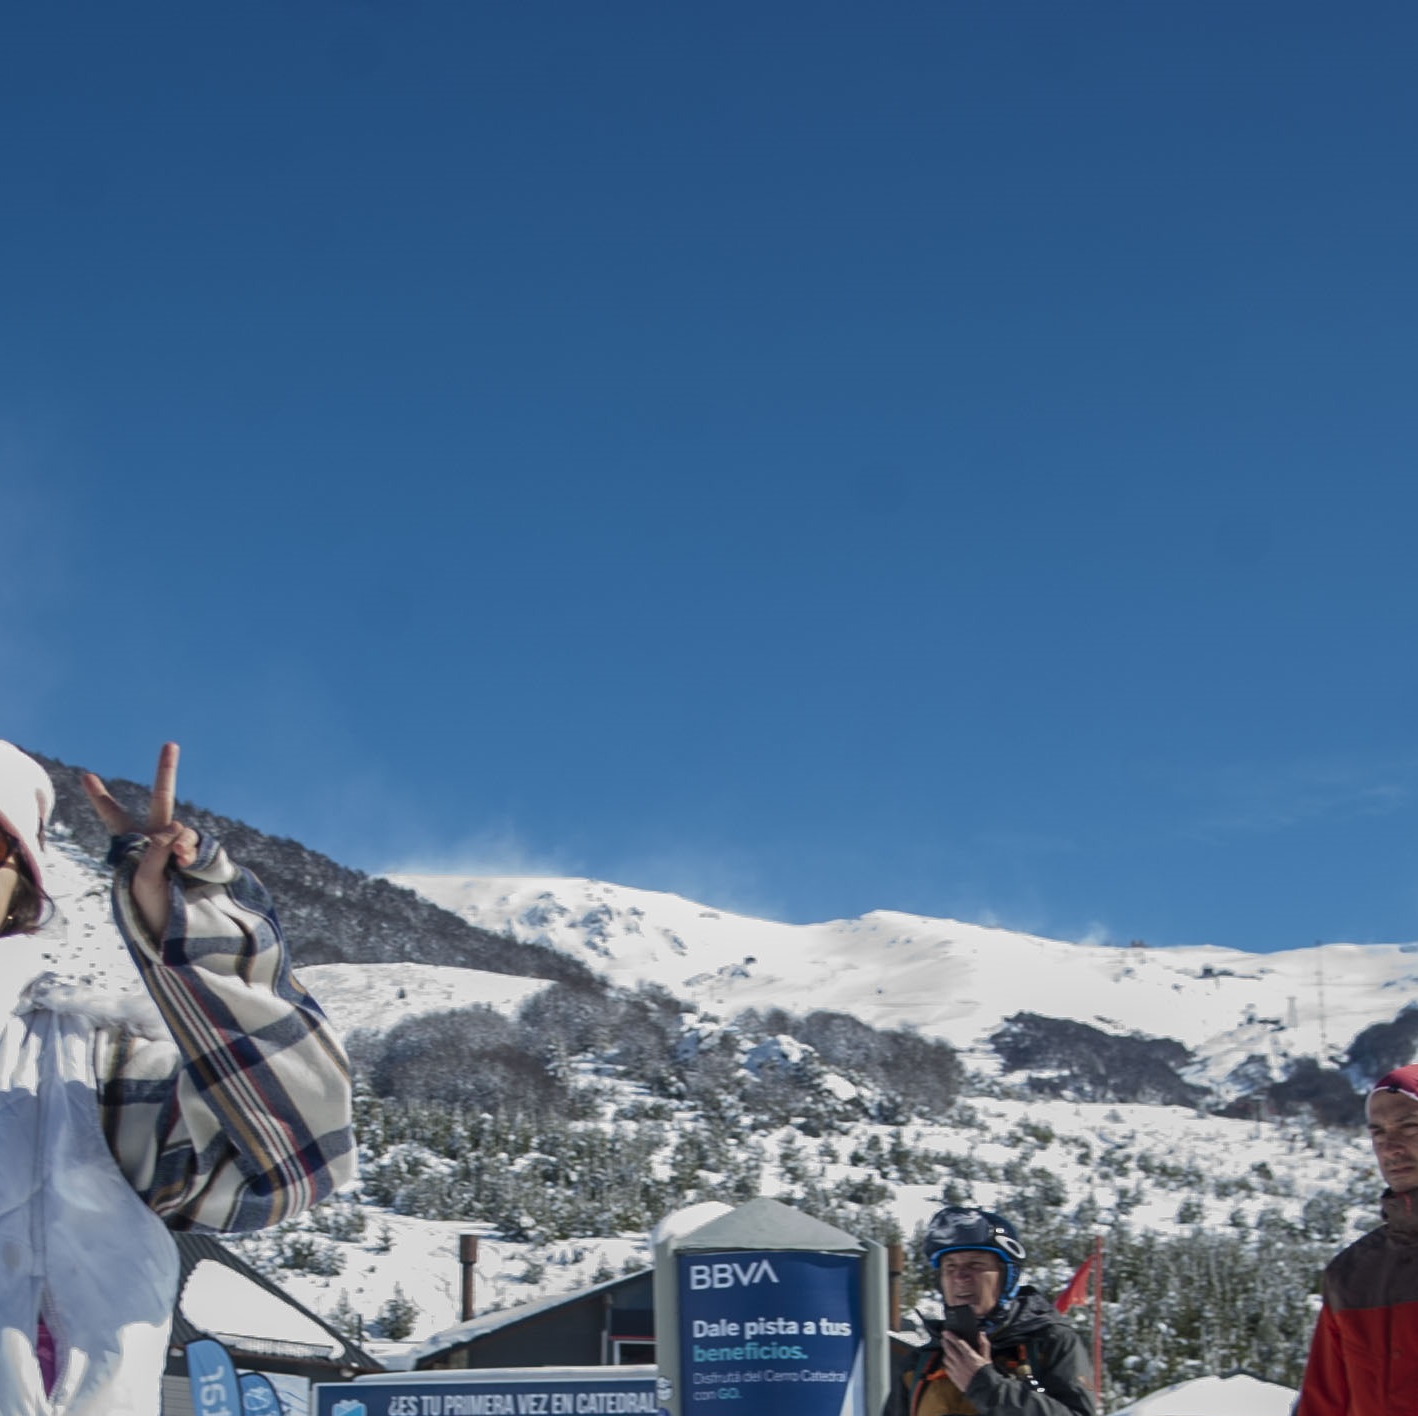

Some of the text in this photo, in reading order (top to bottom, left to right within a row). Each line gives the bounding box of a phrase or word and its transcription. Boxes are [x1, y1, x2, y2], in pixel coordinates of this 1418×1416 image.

[690, 1260, 779, 1290] BBVA
[692, 1317, 852, 1340] Dale pista a tus
[693, 1341, 809, 1362] beneficios.
[743, 1371, 762, 1383] del
[764, 1369, 799, 1383] Cerro
[800, 1369, 848, 1383] Catedral
[387, 1392, 659, 1416] ¿ES TU PRIMERA VEZ EN CATEDRAL
[693, 1391, 716, 1401] con
